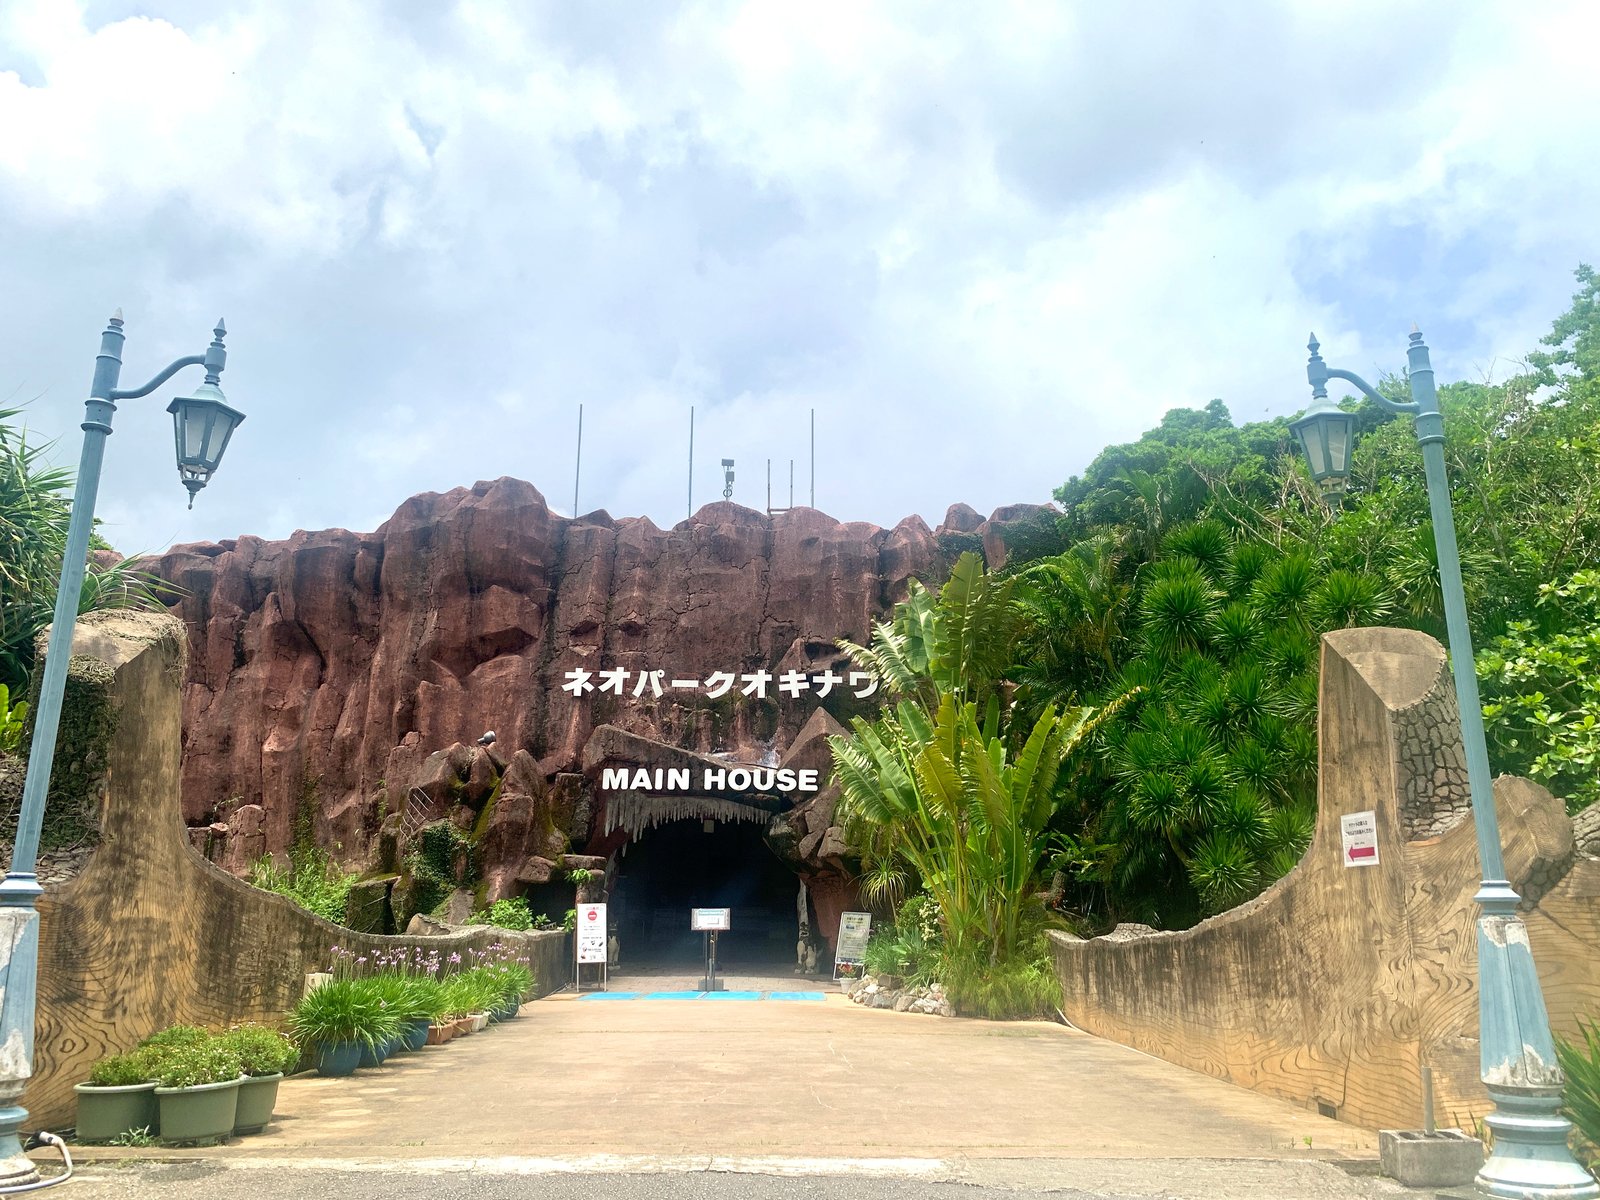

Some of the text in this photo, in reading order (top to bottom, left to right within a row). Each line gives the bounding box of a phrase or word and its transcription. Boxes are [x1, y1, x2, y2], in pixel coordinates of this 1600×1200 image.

[561, 667, 879, 699] ネオパークオキナワ
[602, 768, 818, 792] MAIN HOUSE
